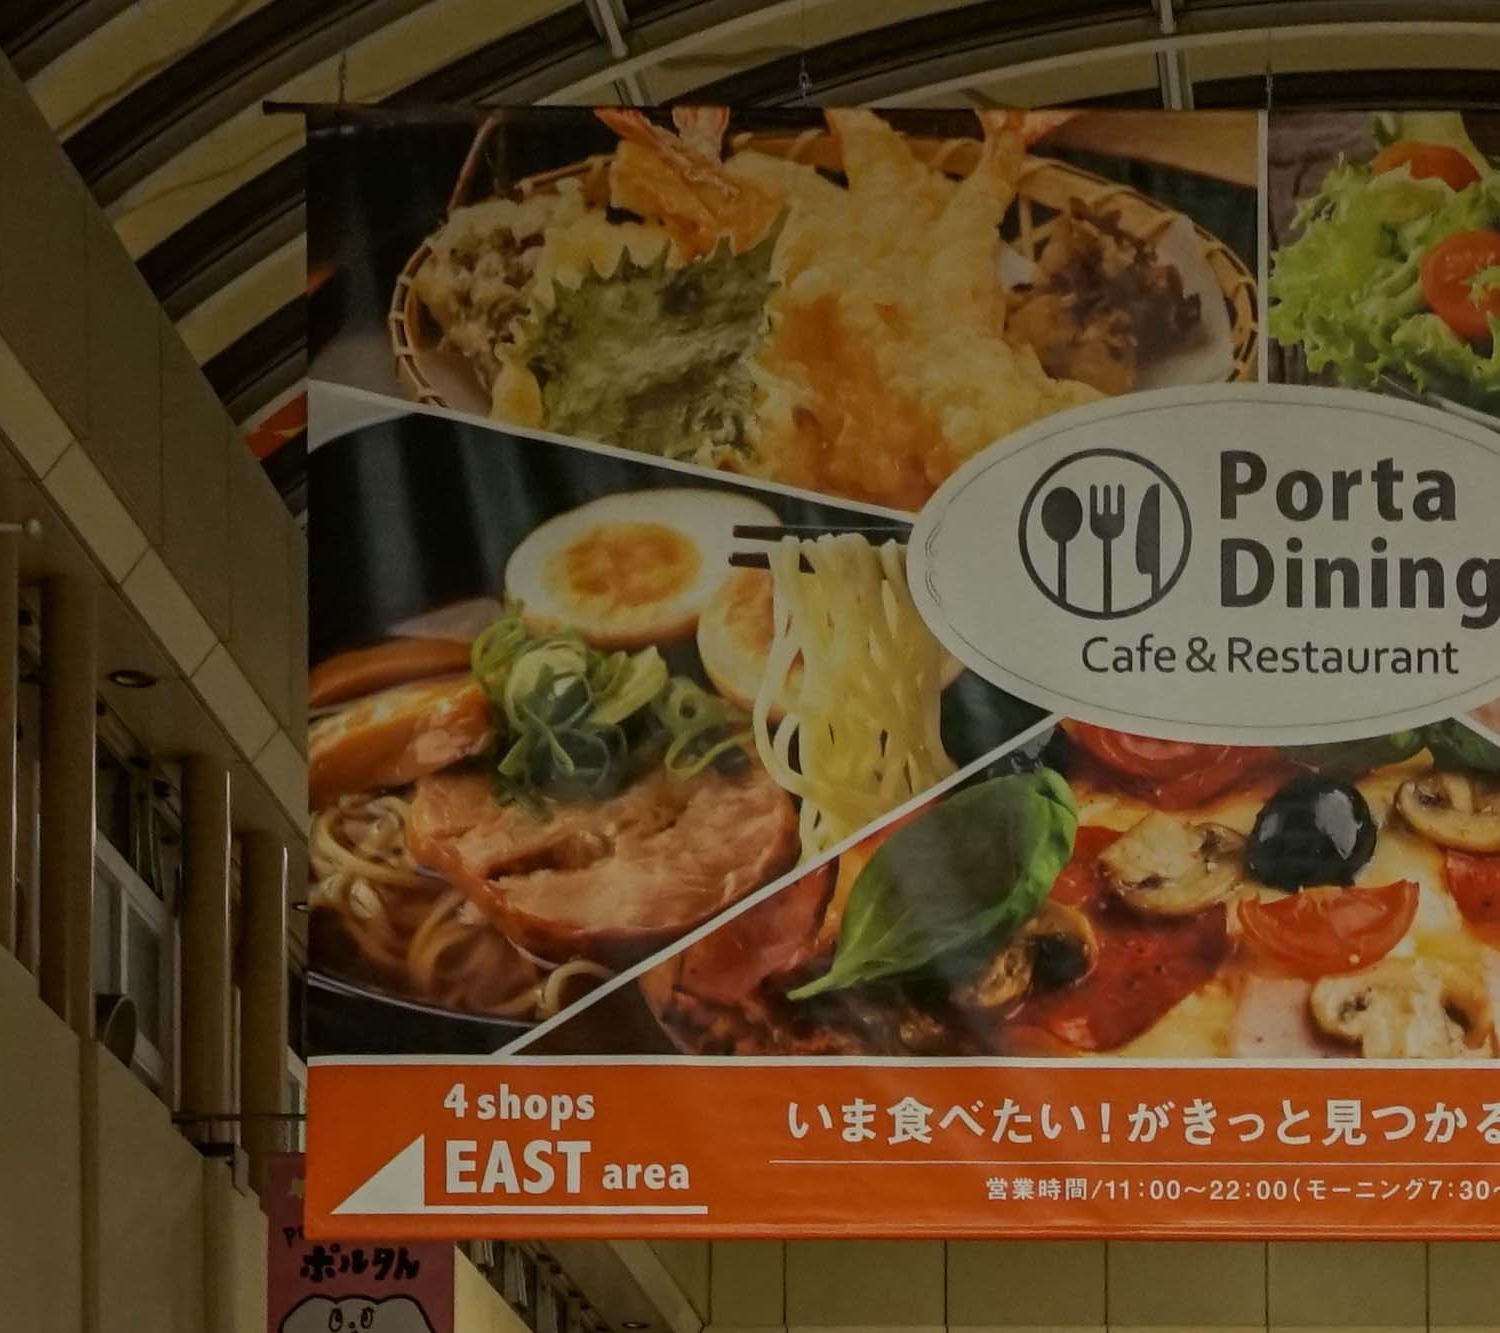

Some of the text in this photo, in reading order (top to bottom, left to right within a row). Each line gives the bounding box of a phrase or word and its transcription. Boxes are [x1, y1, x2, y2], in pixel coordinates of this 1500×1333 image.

[1220, 450, 1458, 522] Porta
[1081, 633, 1459, 675] Cafe & Restaurant
[443, 1083, 595, 1129] 4 shops
[445, 1139, 690, 1194] EAST area
[299, 1242, 421, 1283] ポルタん
